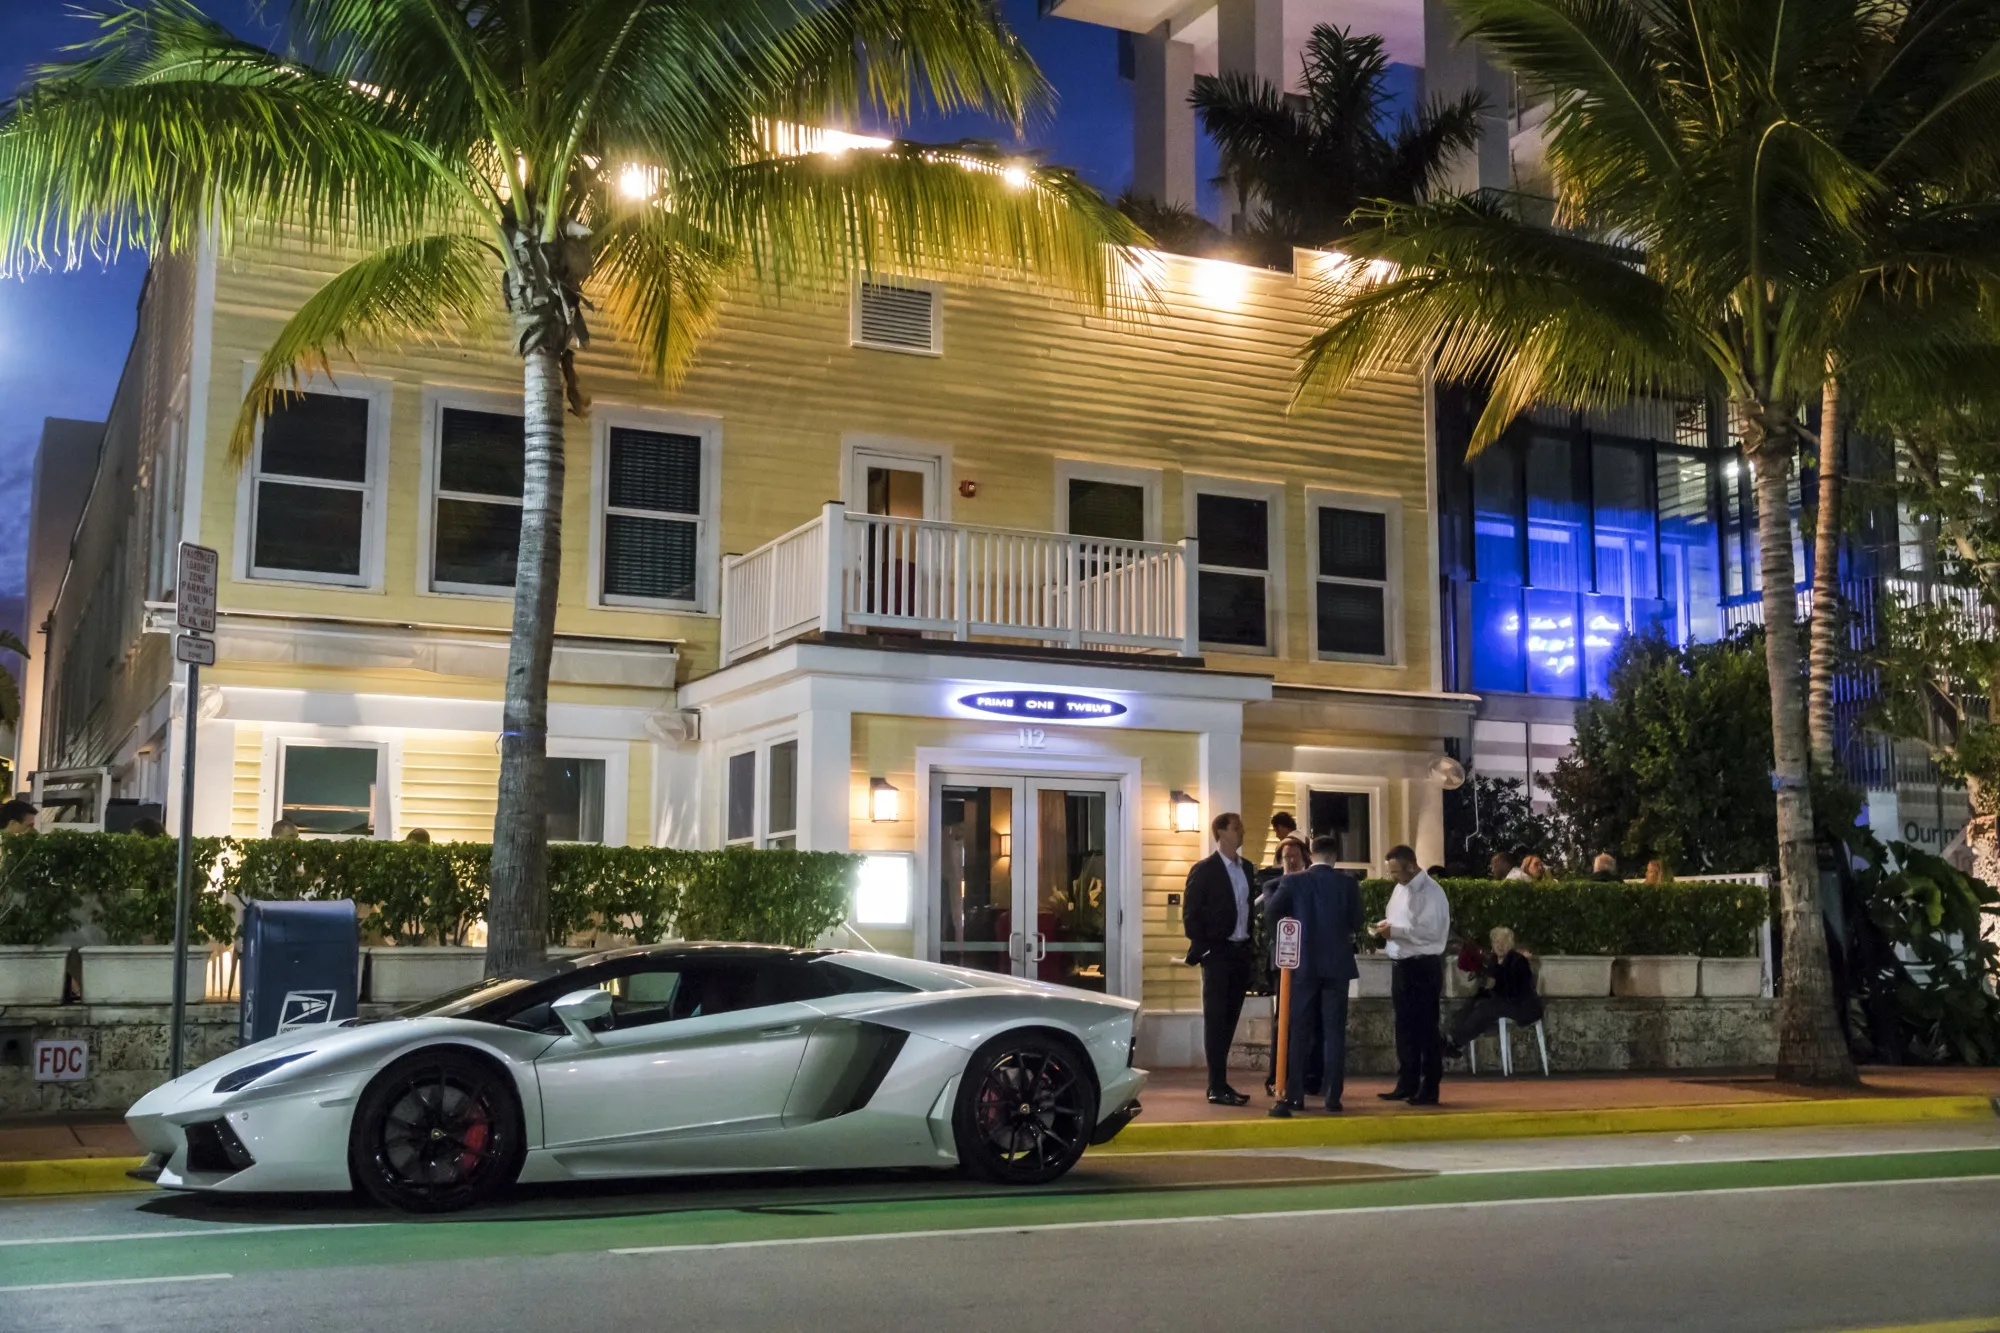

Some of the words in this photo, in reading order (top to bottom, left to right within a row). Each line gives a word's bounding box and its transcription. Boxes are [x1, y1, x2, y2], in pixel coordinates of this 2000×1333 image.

[187, 560, 210, 573] LOADING
[189, 572, 206, 584] ZONE
[182, 580, 213, 597] PARKING
[187, 593, 207, 606] ONLY
[977, 697, 1014, 708] PRIME
[1025, 700, 1055, 710] ONE
[1066, 702, 1112, 713] TWELVE
[1018, 728, 1046, 749] 112
[1904, 821, 1938, 843] Our
[39, 1046, 82, 1073] FDC
